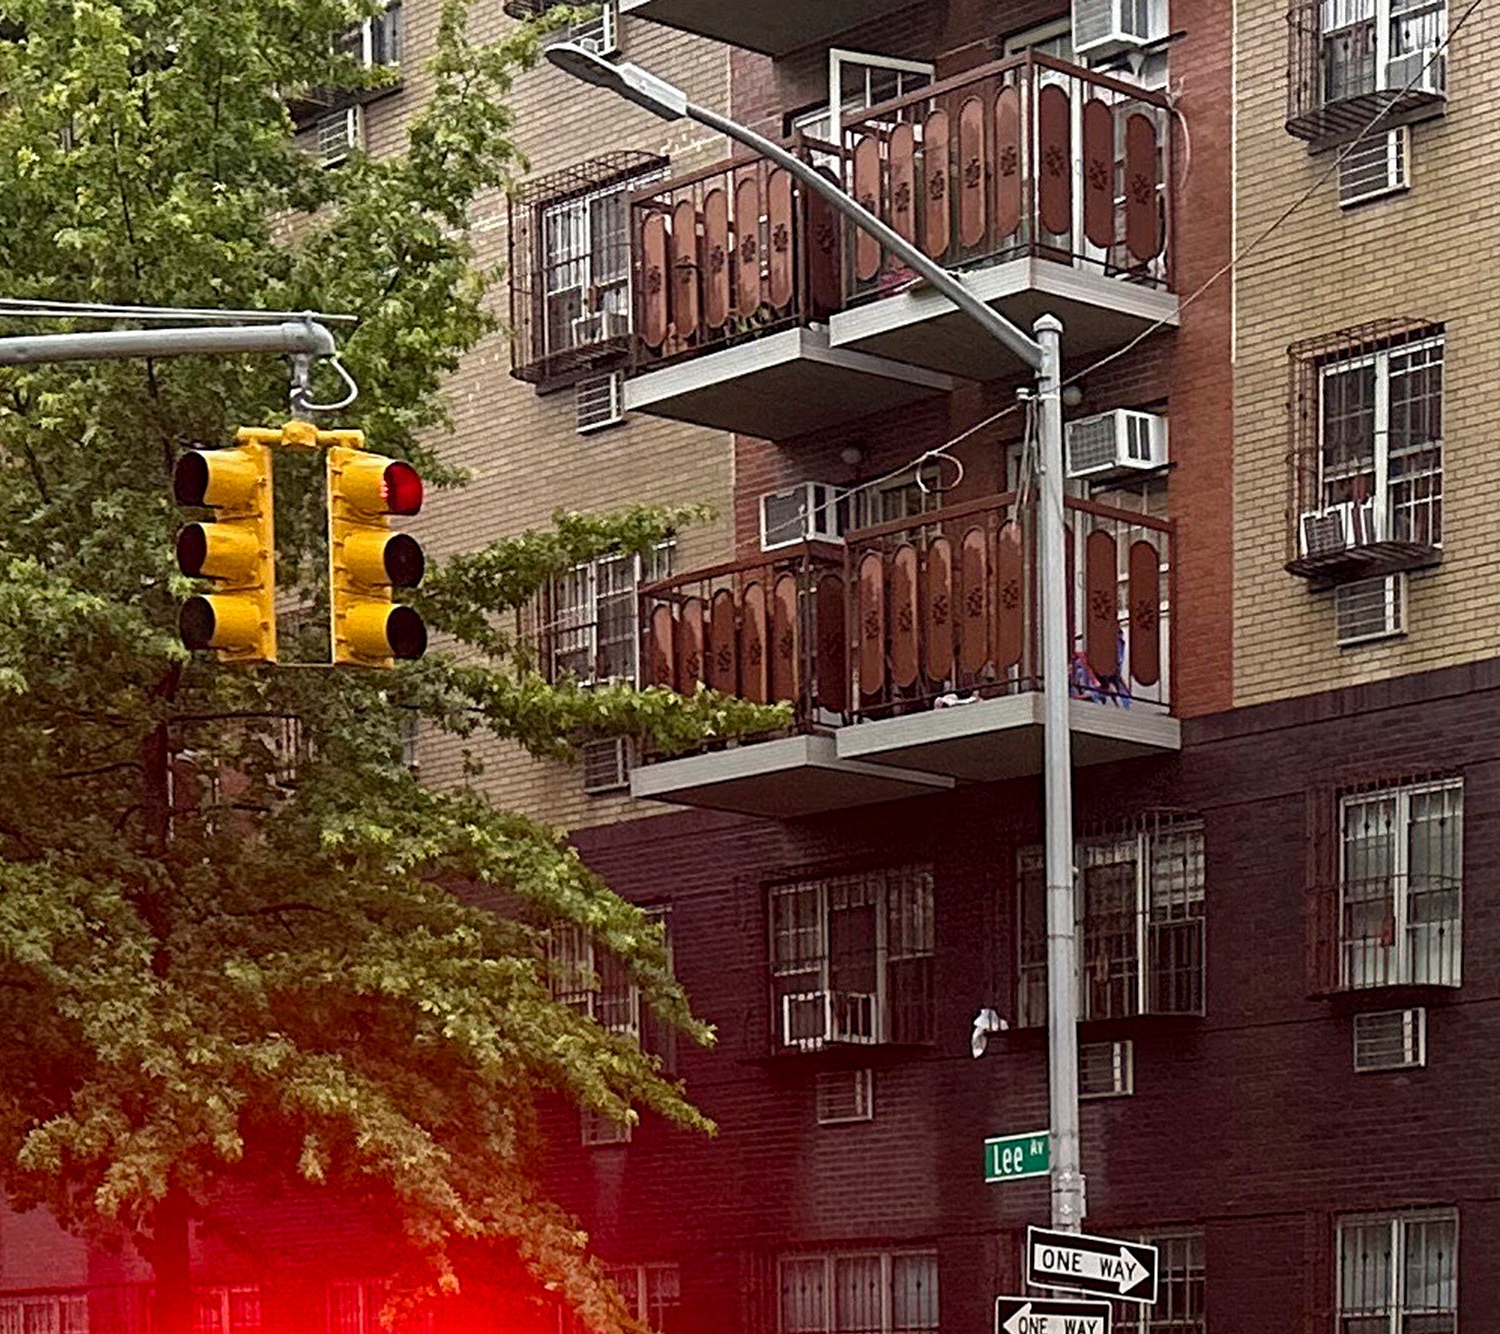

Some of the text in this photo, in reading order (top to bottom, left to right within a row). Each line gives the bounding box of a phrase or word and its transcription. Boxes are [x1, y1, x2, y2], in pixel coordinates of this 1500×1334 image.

[993, 1145, 1024, 1175] Lee
[1042, 1249, 1138, 1282] ONE WAY
